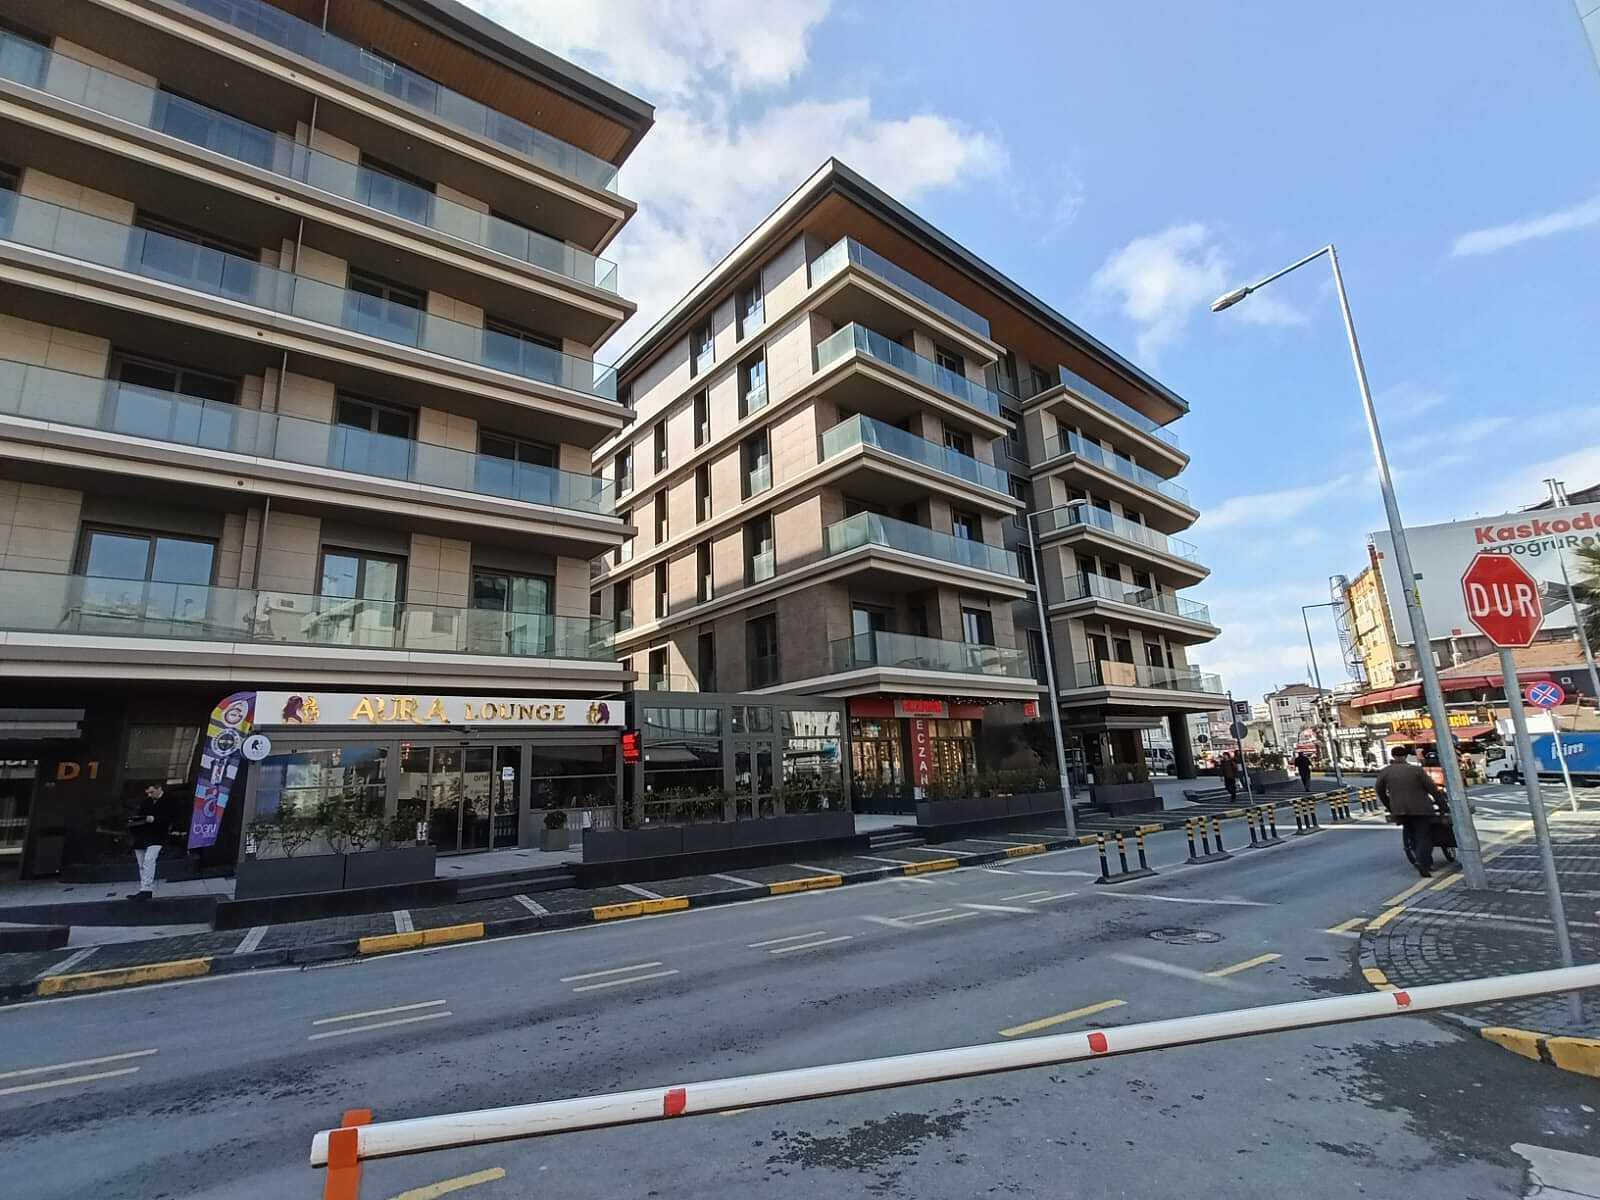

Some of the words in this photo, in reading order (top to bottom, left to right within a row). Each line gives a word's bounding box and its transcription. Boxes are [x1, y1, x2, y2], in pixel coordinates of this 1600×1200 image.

[1469, 582, 1537, 618] DUR
[350, 696, 449, 725] AURA
[463, 702, 566, 721] LOUNGE
